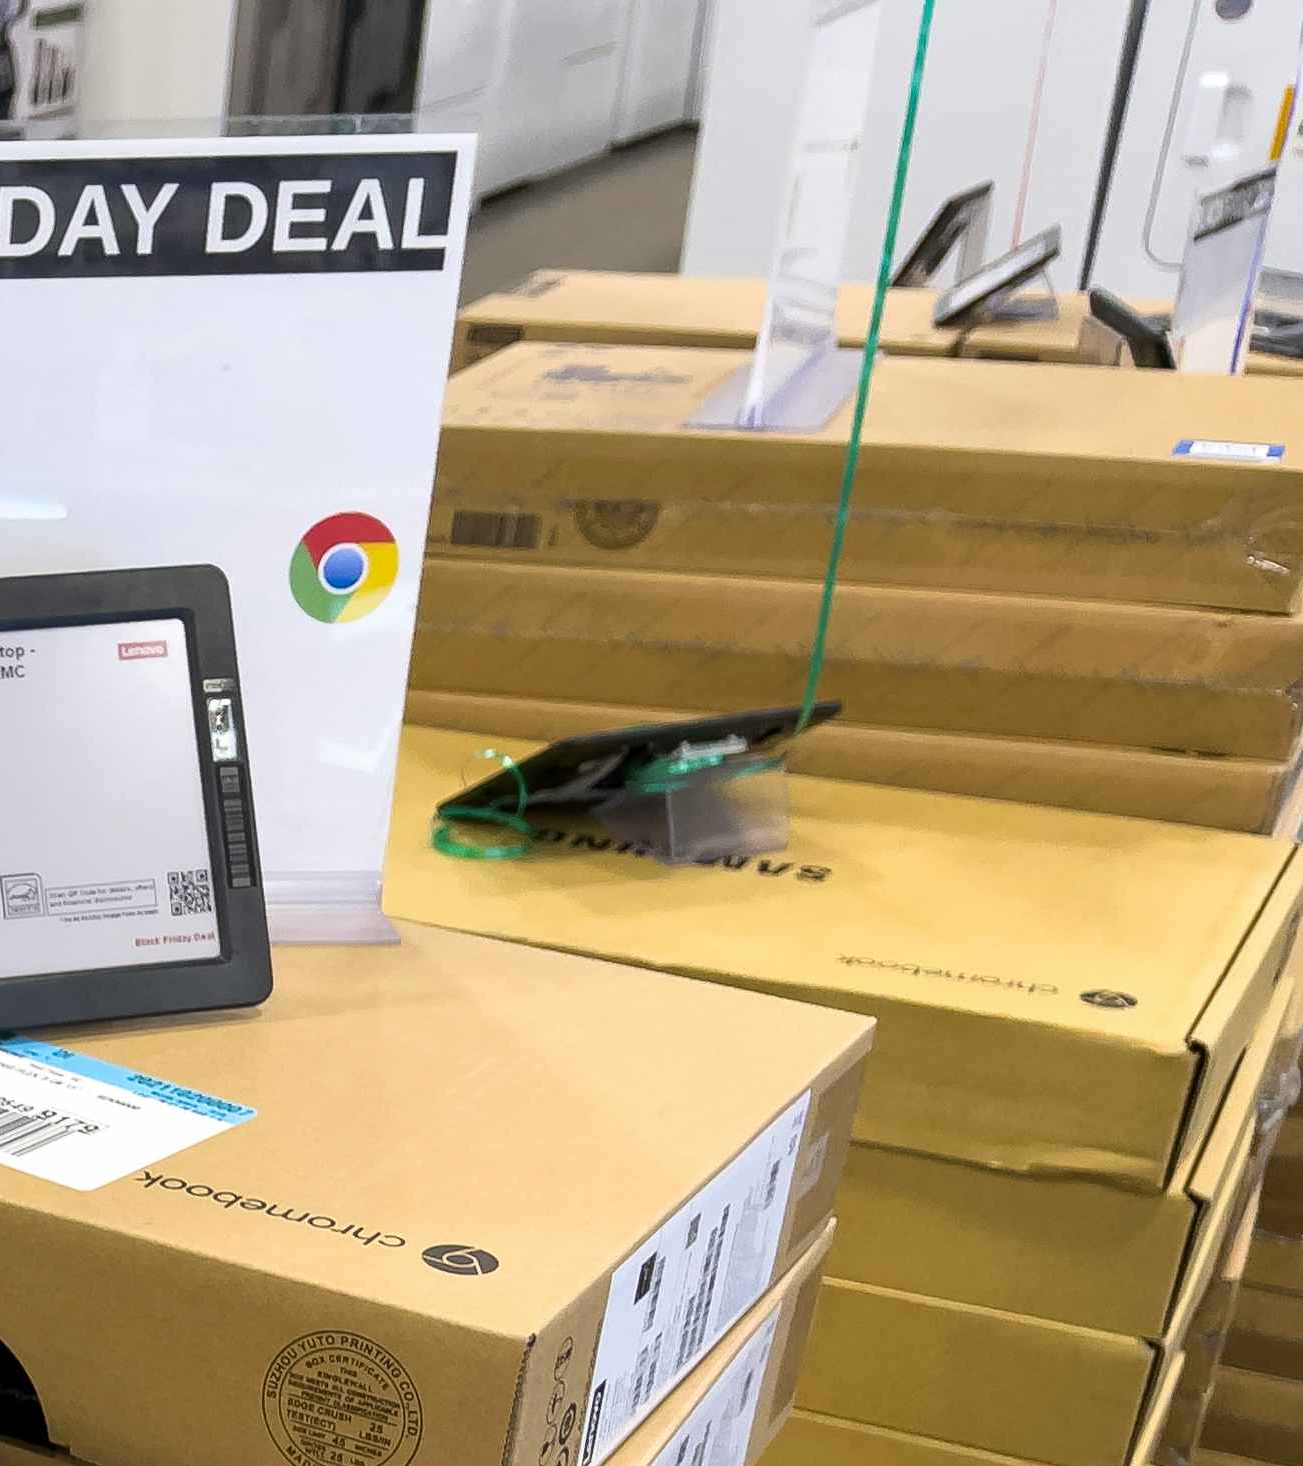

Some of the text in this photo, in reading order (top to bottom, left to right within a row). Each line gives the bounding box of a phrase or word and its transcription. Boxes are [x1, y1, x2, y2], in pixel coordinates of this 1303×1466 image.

[206, 177, 449, 255] DEAL
[120, 643, 166, 660] Lenovo
[835, 952, 1060, 996] chromebook
[137, 1168, 407, 1250] chromebook
[266, 1347, 298, 1400] SUZHOU
[298, 1334, 336, 1352] YUTO
[339, 1335, 402, 1379] PRINTING
[287, 1398, 352, 1424] EDGE CRUSH
